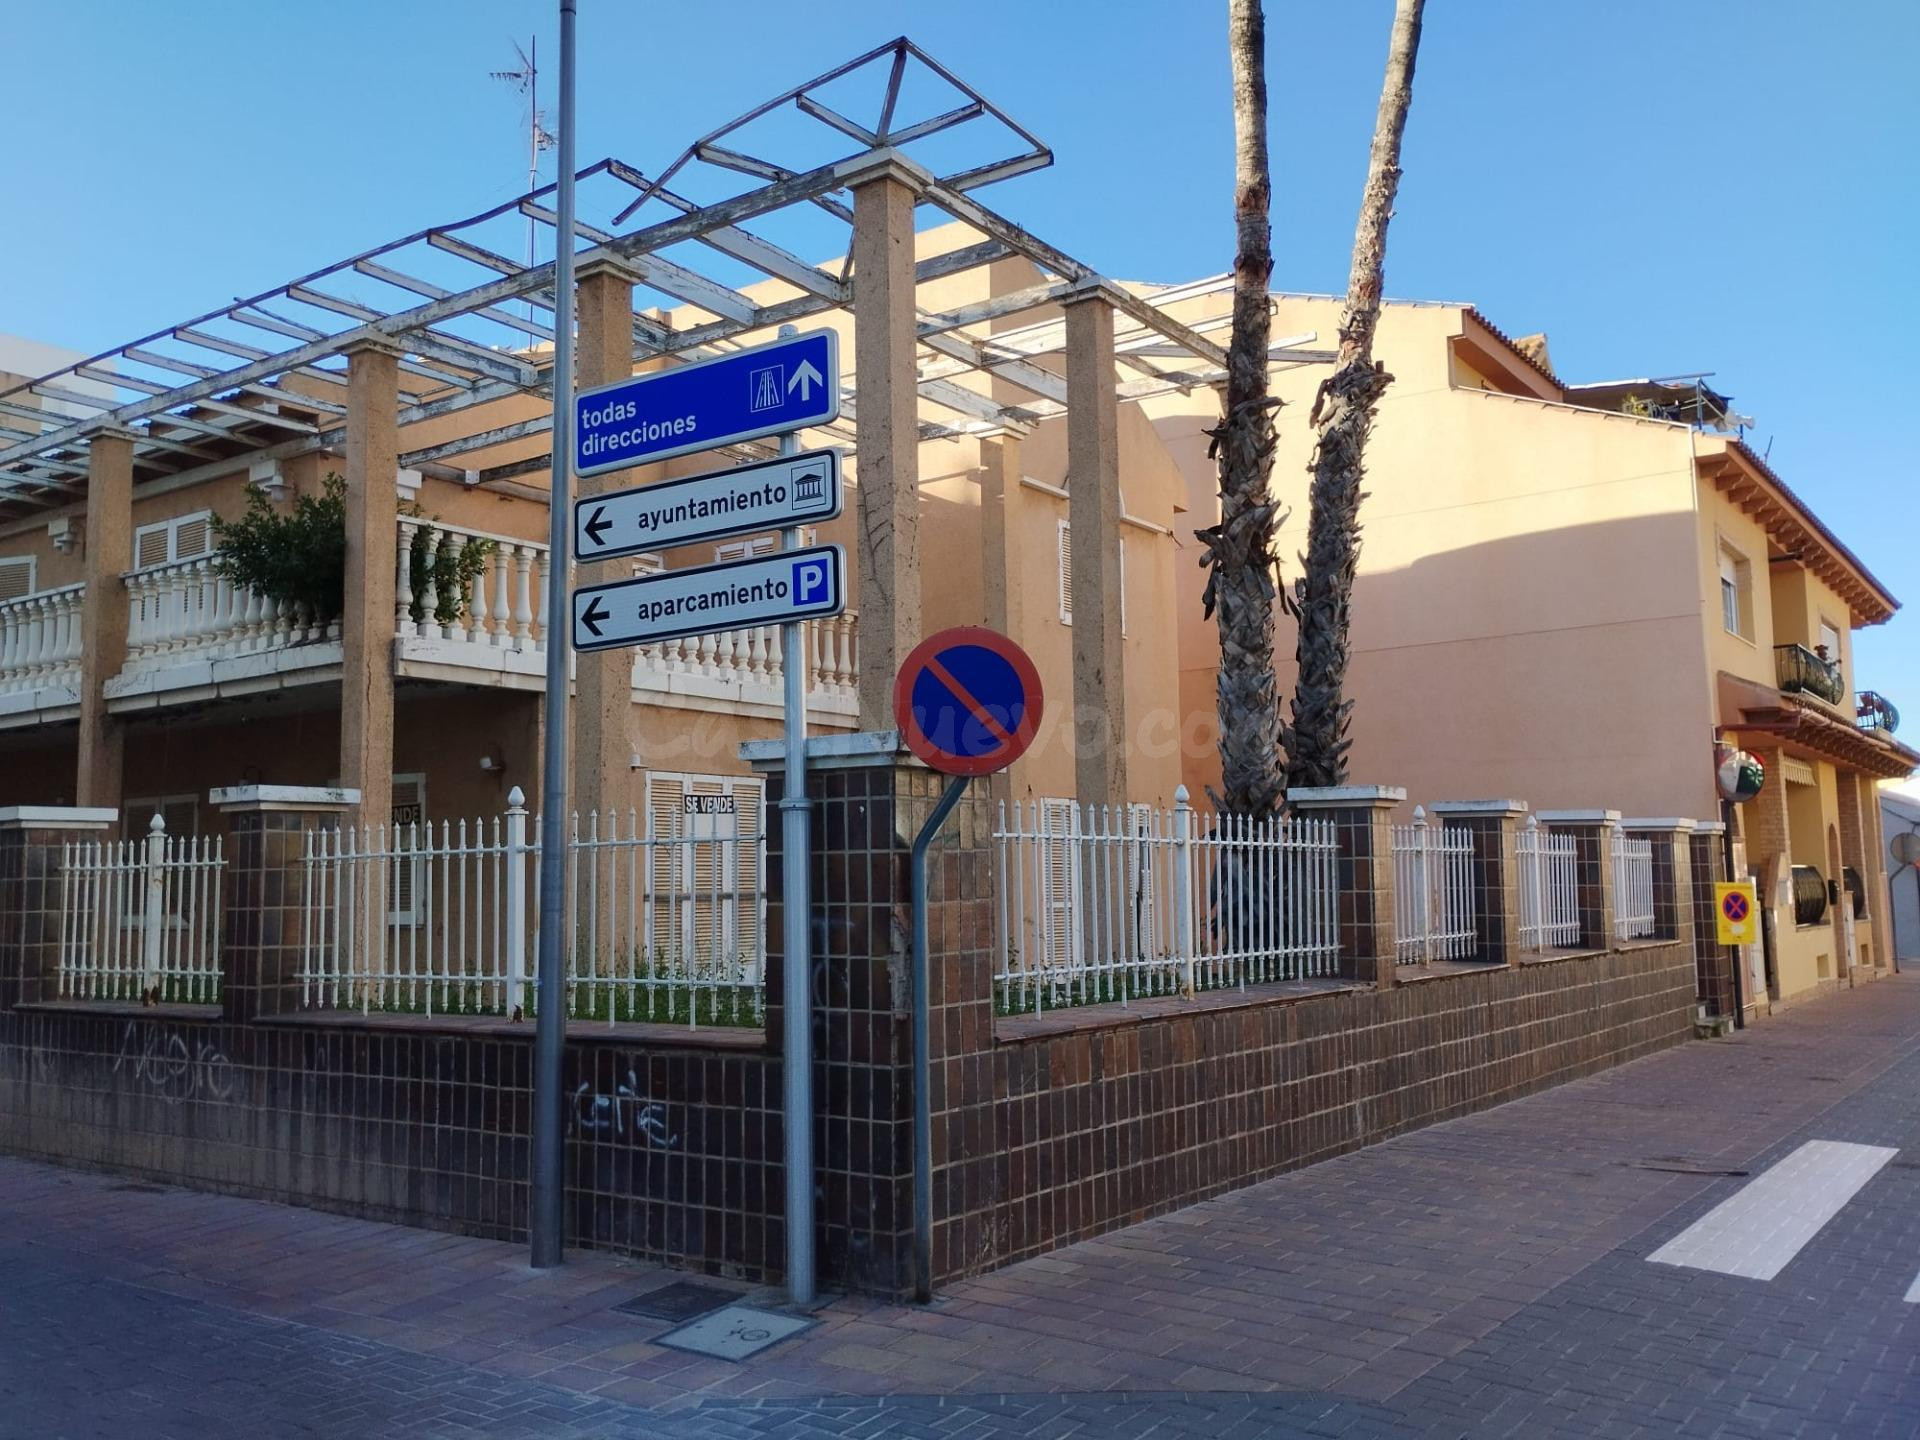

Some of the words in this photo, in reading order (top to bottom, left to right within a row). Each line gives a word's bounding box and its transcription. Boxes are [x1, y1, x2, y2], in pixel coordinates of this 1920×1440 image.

[582, 401, 637, 429] todas
[582, 415, 697, 456] direcciones
[638, 482, 787, 531] ayuntamiento
[638, 577, 788, 622] aparcamiento
[800, 563, 823, 601] P
[685, 796, 698, 813] SE
[700, 796, 733, 813] VENDE
